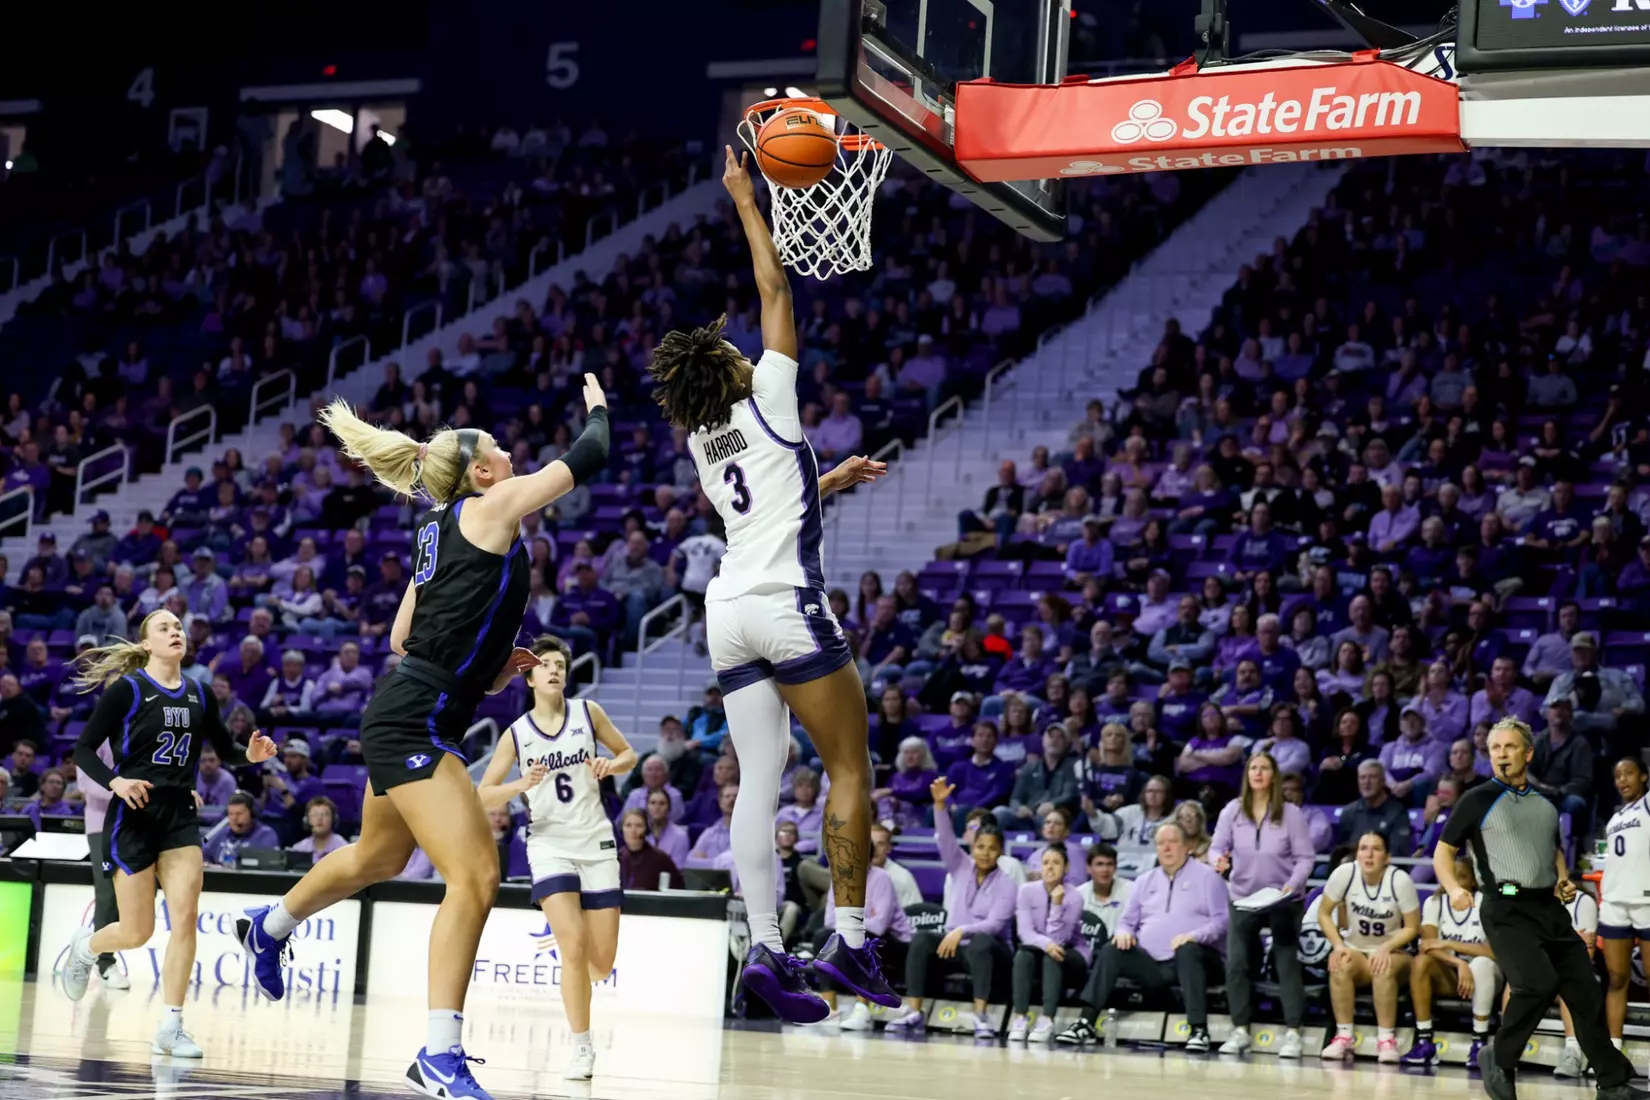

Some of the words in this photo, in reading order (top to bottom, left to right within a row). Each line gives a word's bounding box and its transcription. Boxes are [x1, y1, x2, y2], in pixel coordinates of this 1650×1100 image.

[547, 41, 580, 89] 5
[128, 66, 155, 108] 4
[703, 428, 748, 466] HARROD
[723, 461, 754, 516] 3
[163, 706, 190, 728] BYU
[152, 731, 192, 767] 24
[555, 772, 575, 804] 6
[1615, 834, 1626, 857] 0
[1359, 920, 1386, 936] 99
[214, 951, 342, 994] Cisti
